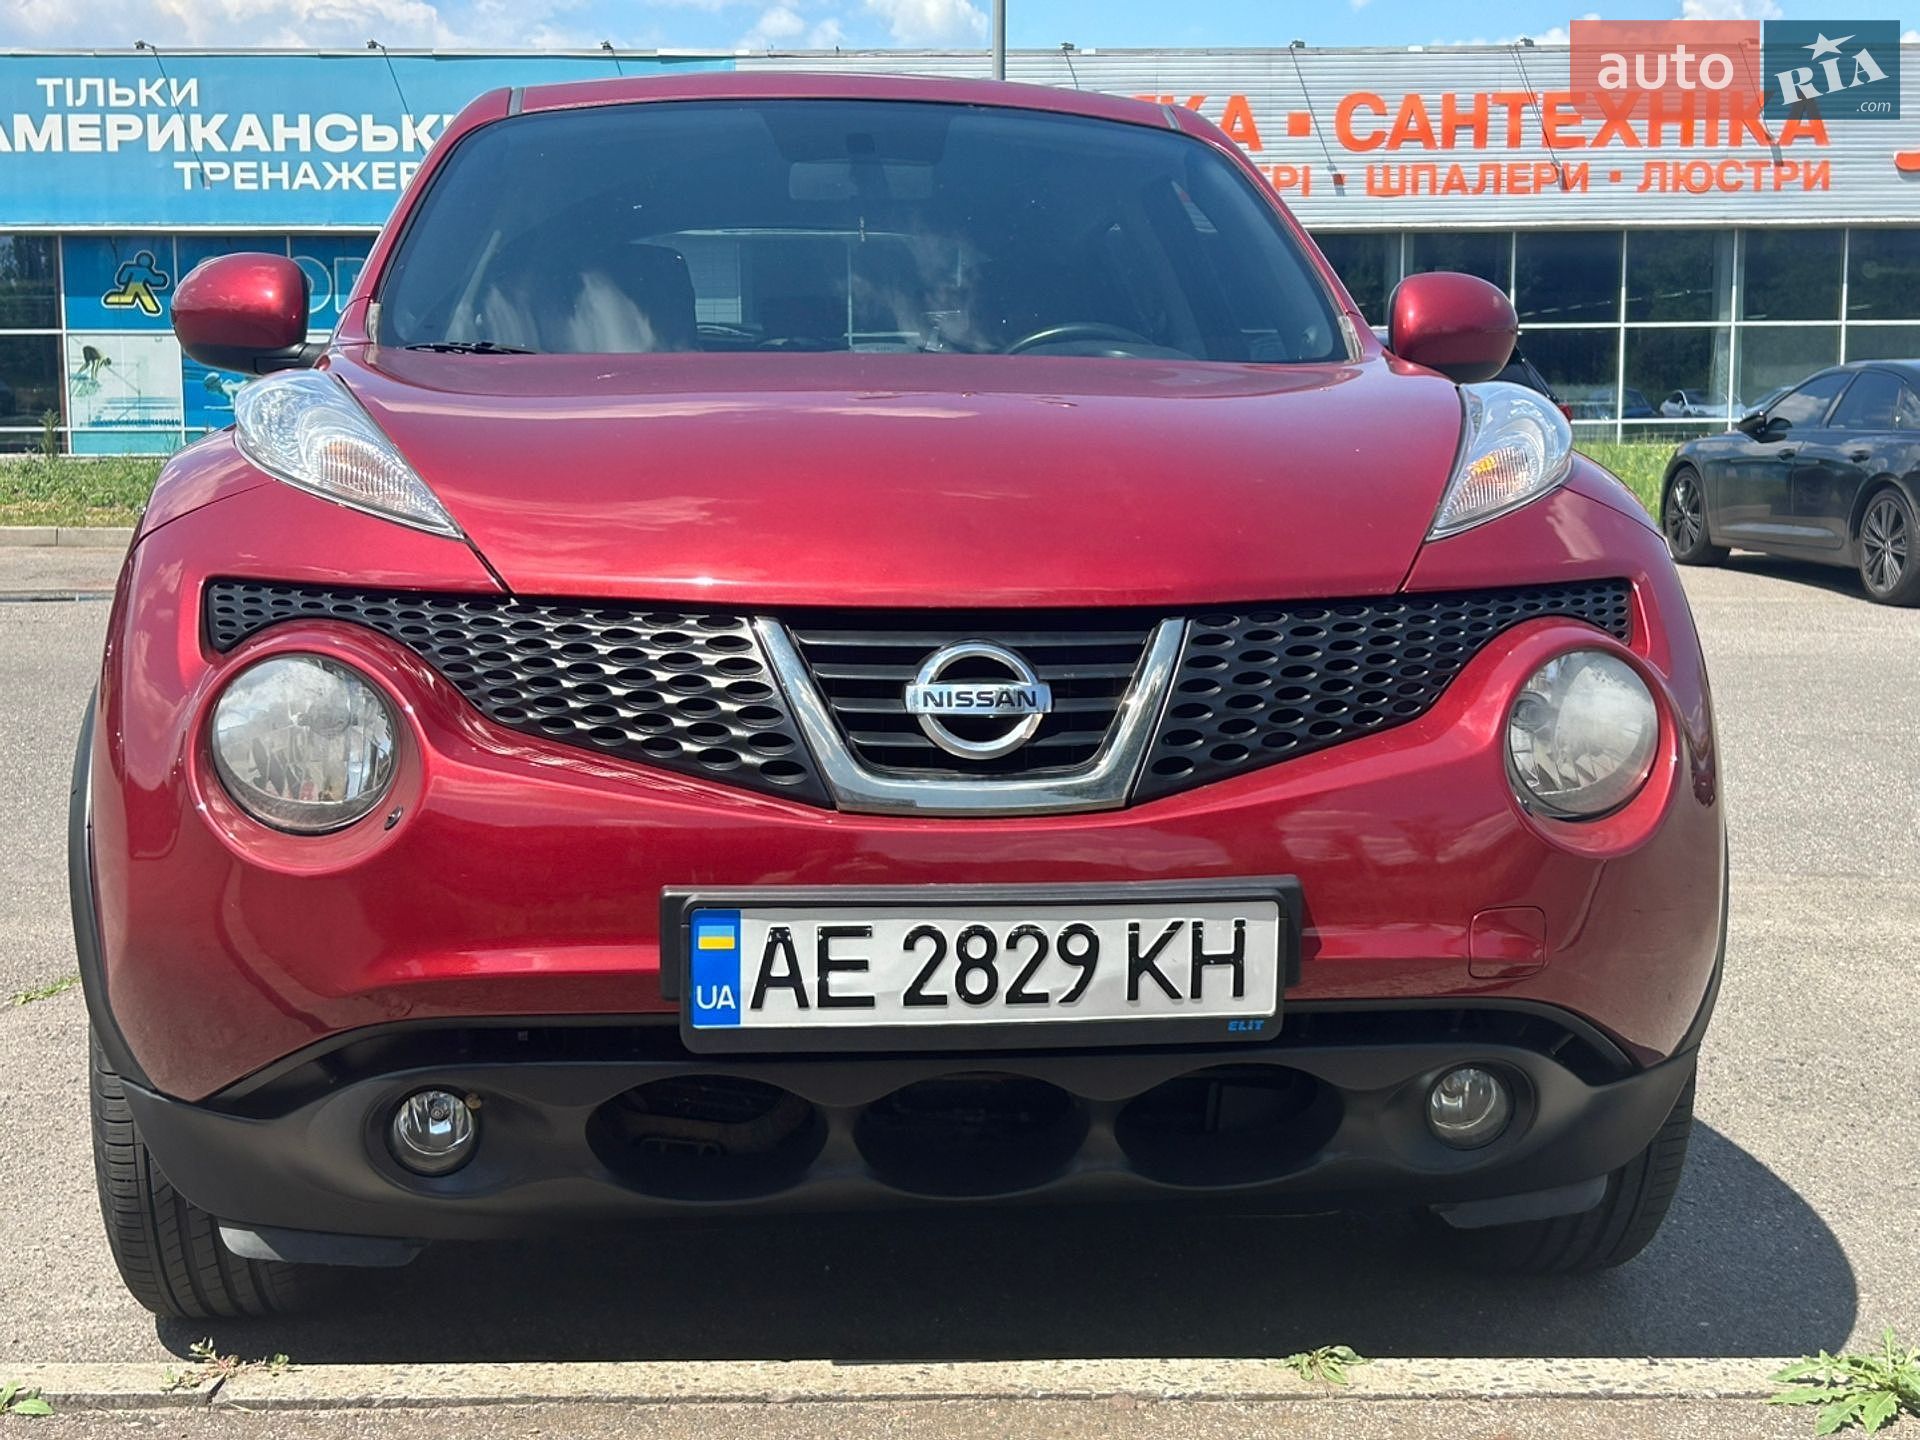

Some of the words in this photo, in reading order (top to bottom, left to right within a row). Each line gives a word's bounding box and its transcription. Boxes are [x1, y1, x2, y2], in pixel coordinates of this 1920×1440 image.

[36, 77, 199, 107] ТІЛЬКИ
[0, 114, 455, 152] МЕРИКАНСЬК
[1334, 91, 1830, 151] САНТЕХНІКА
[1364, 163, 1589, 196] ШПАЛЕРИ
[1637, 160, 1830, 193] ЛЮСТРИ
[922, 691, 1037, 708] NISSAN
[749, 926, 876, 1010] AE
[902, 923, 1101, 1006] 2829
[1126, 918, 1247, 1001] KH
[696, 985, 737, 1009] UA
[1227, 1020, 1265, 1032] ELIT
